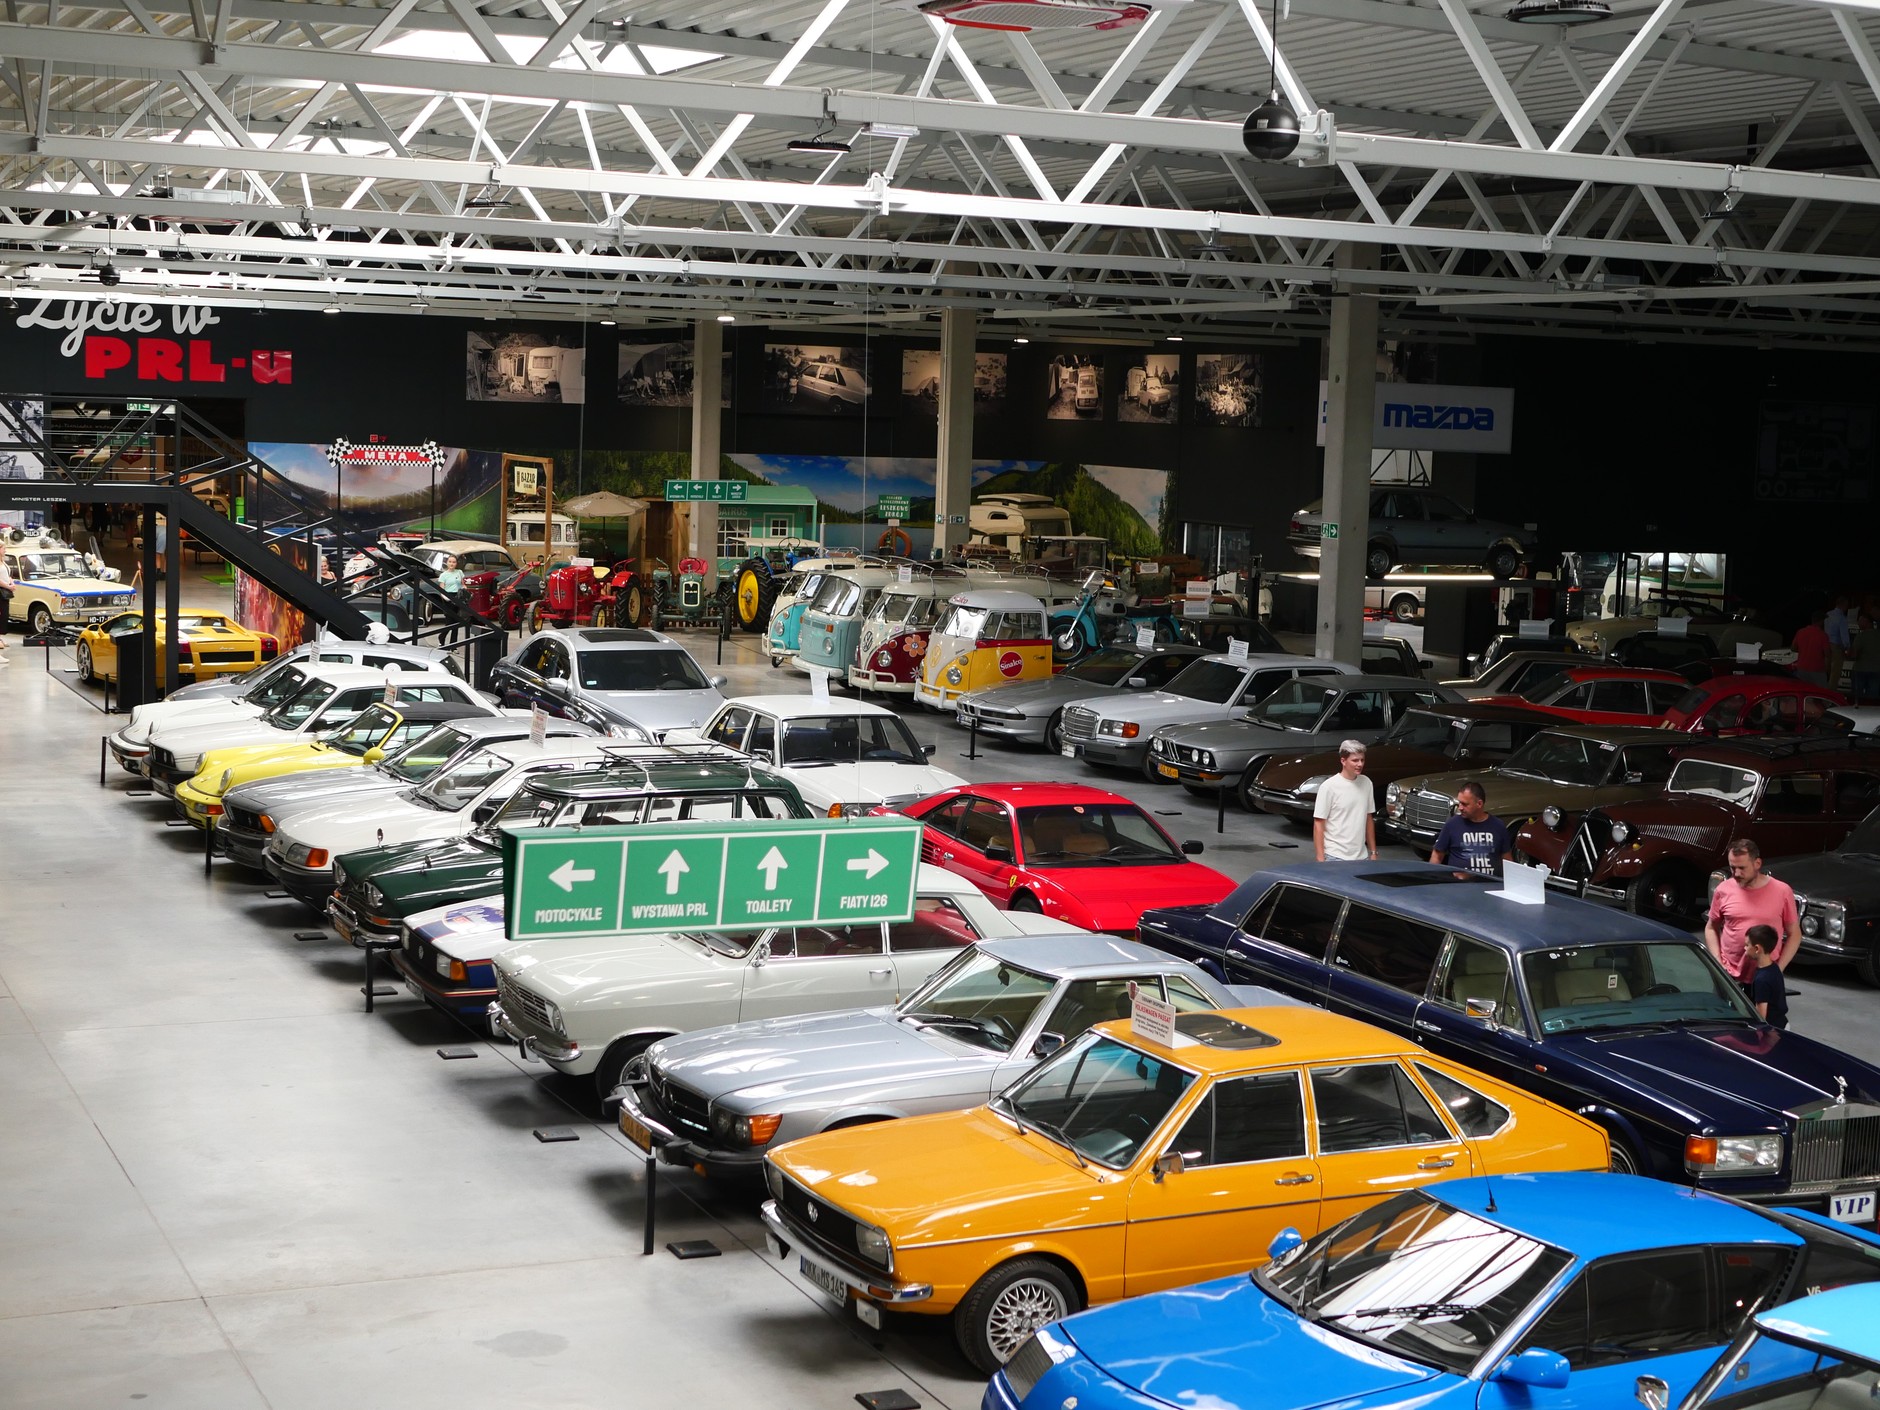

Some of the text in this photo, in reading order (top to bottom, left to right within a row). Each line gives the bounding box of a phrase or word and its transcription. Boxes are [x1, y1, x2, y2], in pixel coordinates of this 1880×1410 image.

[1383, 403, 1494, 431] mazda
[364, 451, 408, 460] META
[1000, 659, 1023, 671] Sinalco
[1462, 832, 1494, 846] OVER
[1470, 853, 1492, 867] THE
[745, 899, 792, 914] TOALETY
[840, 894, 888, 909] FIATY 126
[534, 907, 603, 924] MOTOCYKLE
[631, 903, 708, 919] WYSTAWA PRL
[1835, 1197, 1871, 1215] VIP
[830, 1275, 845, 1299] 145
[1806, 1285, 1822, 1296] V6
